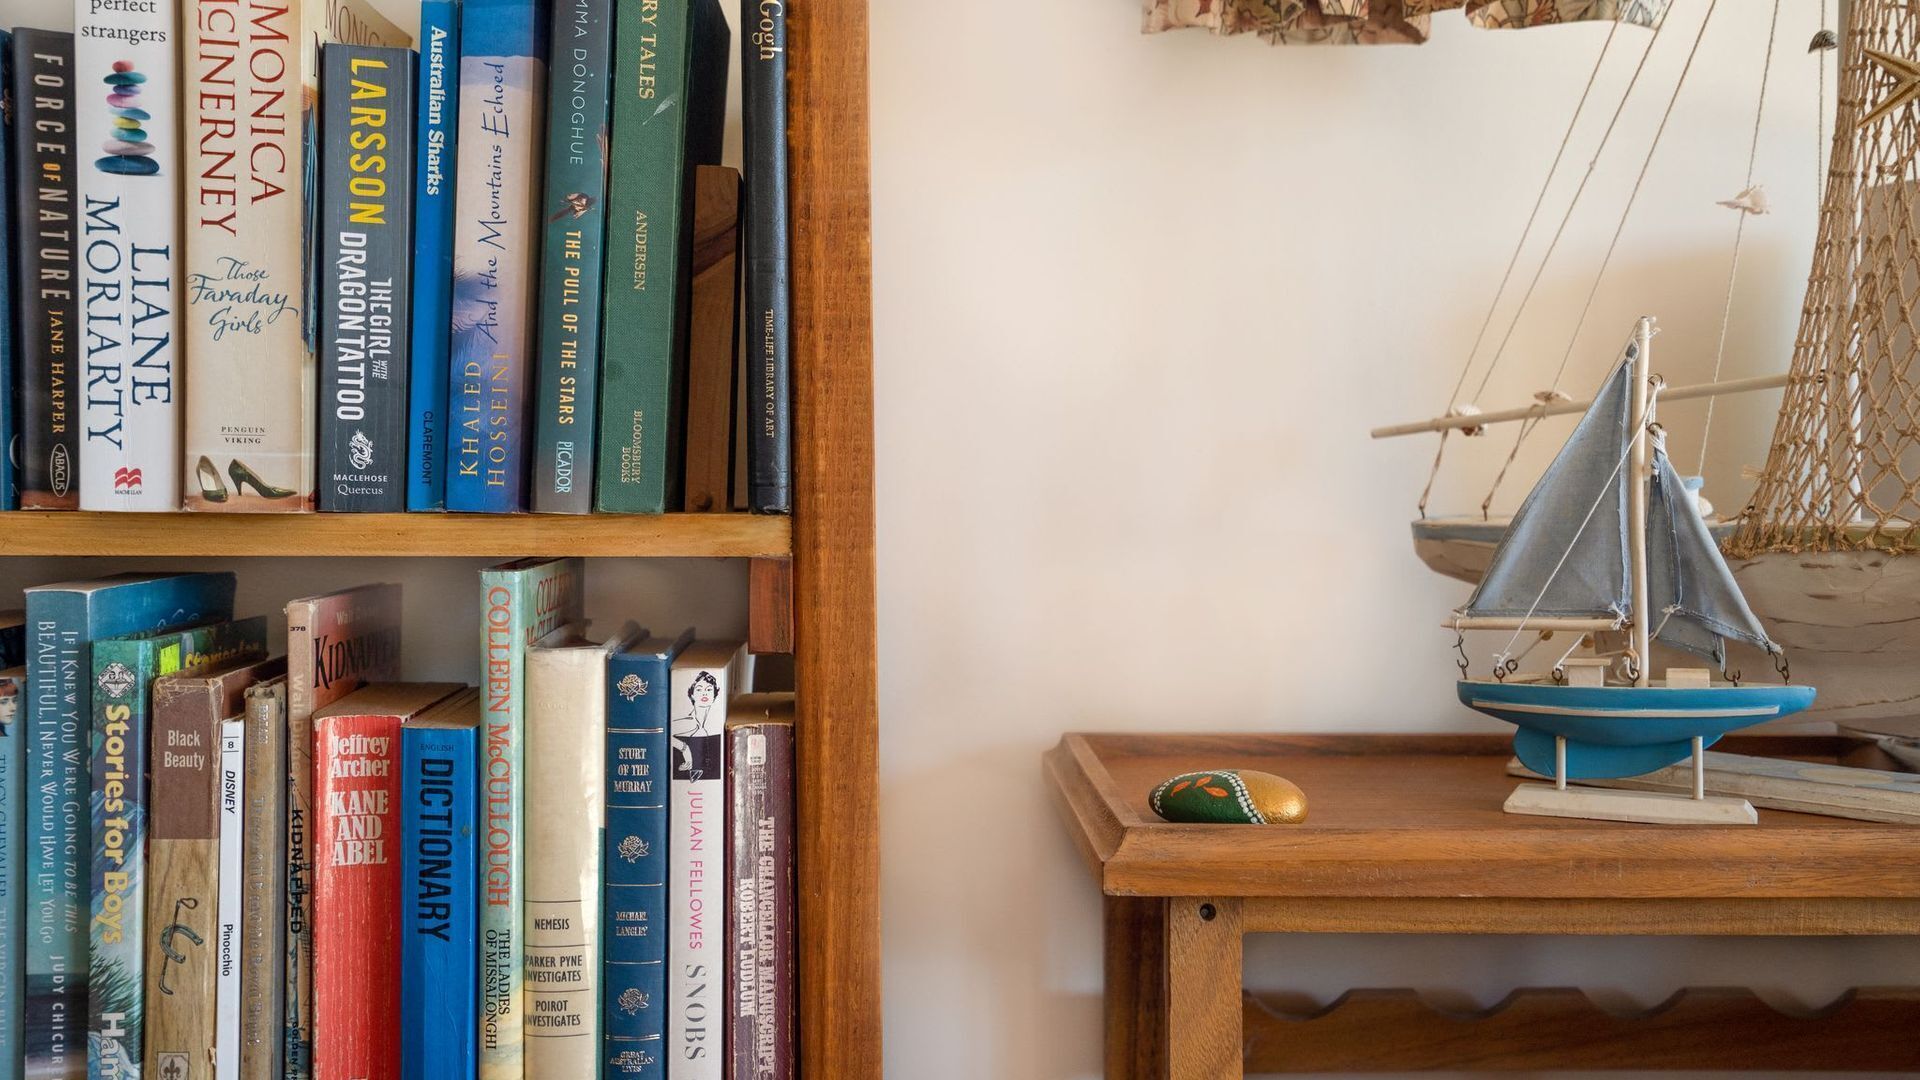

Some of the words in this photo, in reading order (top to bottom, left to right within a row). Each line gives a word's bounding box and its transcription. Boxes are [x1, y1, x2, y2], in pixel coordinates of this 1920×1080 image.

[81, 25, 166, 45] strangers
[751, 0, 784, 60] Gogh
[428, 25, 448, 125] Australian
[638, 34, 657, 99] TALES
[33, 52, 66, 154] FORCE
[249, 2, 289, 205] MONICA
[480, 62, 510, 138] Echoed
[569, 48, 588, 165] DONOGHUE
[348, 57, 390, 225] LARSSON
[42, 162, 62, 182] OF
[426, 129, 445, 196] Sharks
[477, 144, 508, 250] Mountains
[39, 187, 71, 300] NATURE
[565, 230, 582, 259] THE
[634, 210, 646, 291] ANDERSEN
[216, 256, 270, 283] Those
[336, 232, 367, 331] DRAGON
[480, 256, 498, 290] the
[563, 265, 580, 306] PULL
[187, 273, 299, 323] Faraday
[369, 277, 393, 314] THE
[47, 309, 64, 355] JANE
[84, 193, 123, 451] MORIARTY
[130, 242, 172, 406] LIANE
[208, 308, 263, 342] Girls
[366, 314, 393, 360] GIRL
[475, 299, 499, 345] And
[562, 314, 578, 333] OF
[764, 308, 775, 351] TIME-LIFE
[371, 359, 381, 379] THE
[379, 360, 389, 380] WITH
[560, 337, 577, 369] THE
[51, 361, 65, 434] HARPER
[334, 335, 366, 421] TATTOO
[764, 353, 775, 401] LIBRARY
[459, 360, 482, 477] KHALED
[487, 352, 509, 488] HOSSEINI
[558, 375, 575, 425] STARS
[764, 402, 775, 414] OF
[221, 426, 266, 435] PENGUIN
[224, 436, 262, 445] VIKING
[421, 410, 434, 487] CLAREMONT
[631, 409, 643, 485] BLOOMSBURY
[764, 418, 775, 438] ART
[53, 451, 66, 491] ABACUS
[333, 474, 388, 483] MACLEHOSE
[555, 441, 573, 494] PICADOR
[621, 446, 631, 484] BOOKS
[337, 483, 384, 496] Quercus
[61, 630, 79, 645] IF
[487, 586, 512, 714] COLLEEN
[61, 659, 80, 705] KNEW
[61, 710, 80, 744] YOU
[167, 730, 201, 748] Black
[227, 740, 234, 749] 8
[331, 735, 390, 757] Jeffrey
[420, 743, 455, 752] ENGLISH
[39, 730, 57, 779] NEVER
[62, 749, 81, 795] WERE
[104, 704, 131, 813] Stories
[163, 751, 205, 772] Beauty
[331, 757, 391, 778] Archer
[618, 748, 647, 760] STURT
[618, 765, 632, 776] OF
[40, 781, 58, 831] WOULD
[224, 769, 237, 814] DISNEY
[330, 790, 389, 816] KANE
[613, 780, 653, 793] MURRAY
[62, 800, 81, 855] GOING
[337, 815, 382, 841] AND
[486, 723, 511, 909] McCULLOUGH
[687, 790, 704, 851] JULIAN
[758, 816, 776, 852] THE
[40, 835, 57, 868] HAVE
[104, 816, 129, 865] for
[331, 840, 388, 866] ABEL
[417, 758, 455, 943] DICTIONARY
[38, 873, 55, 895] LET
[63, 860, 77, 877] TO
[290, 809, 303, 935] KIDNAPPED
[40, 898, 54, 922] YOU
[64, 882, 78, 898] BE
[95, 871, 130, 945] Boys
[687, 860, 704, 950] FELLOWES
[739, 878, 756, 944] ROBERT
[758, 855, 776, 962] CHANCELLOR
[40, 925, 53, 945] GO
[65, 902, 79, 934] THIS
[534, 918, 570, 930] NEMESIS
[615, 911, 648, 921] MICHAEL
[615, 925, 649, 937] LANGLEY
[221, 923, 234, 977] Pinocchio
[485, 928, 498, 949] OF
[498, 928, 511, 960] THE
[51, 955, 65, 994] JUDY
[525, 954, 557, 968] PARKER
[560, 954, 583, 967] PYNE
[738, 946, 757, 1018] LUDLUM
[485, 951, 498, 1050] MISSALONGHI
[498, 964, 511, 1016] LADIES
[535, 1000, 569, 1012] POIROT
[684, 964, 706, 1061] SNOBS
[758, 964, 777, 1073] MANUSCRIPT
[291, 1021, 299, 1066] GOLDEN
[609, 1056, 655, 1066] AUSTRALIAN
[619, 1050, 646, 1059] GREAT
[621, 1065, 643, 1074] LIVES
